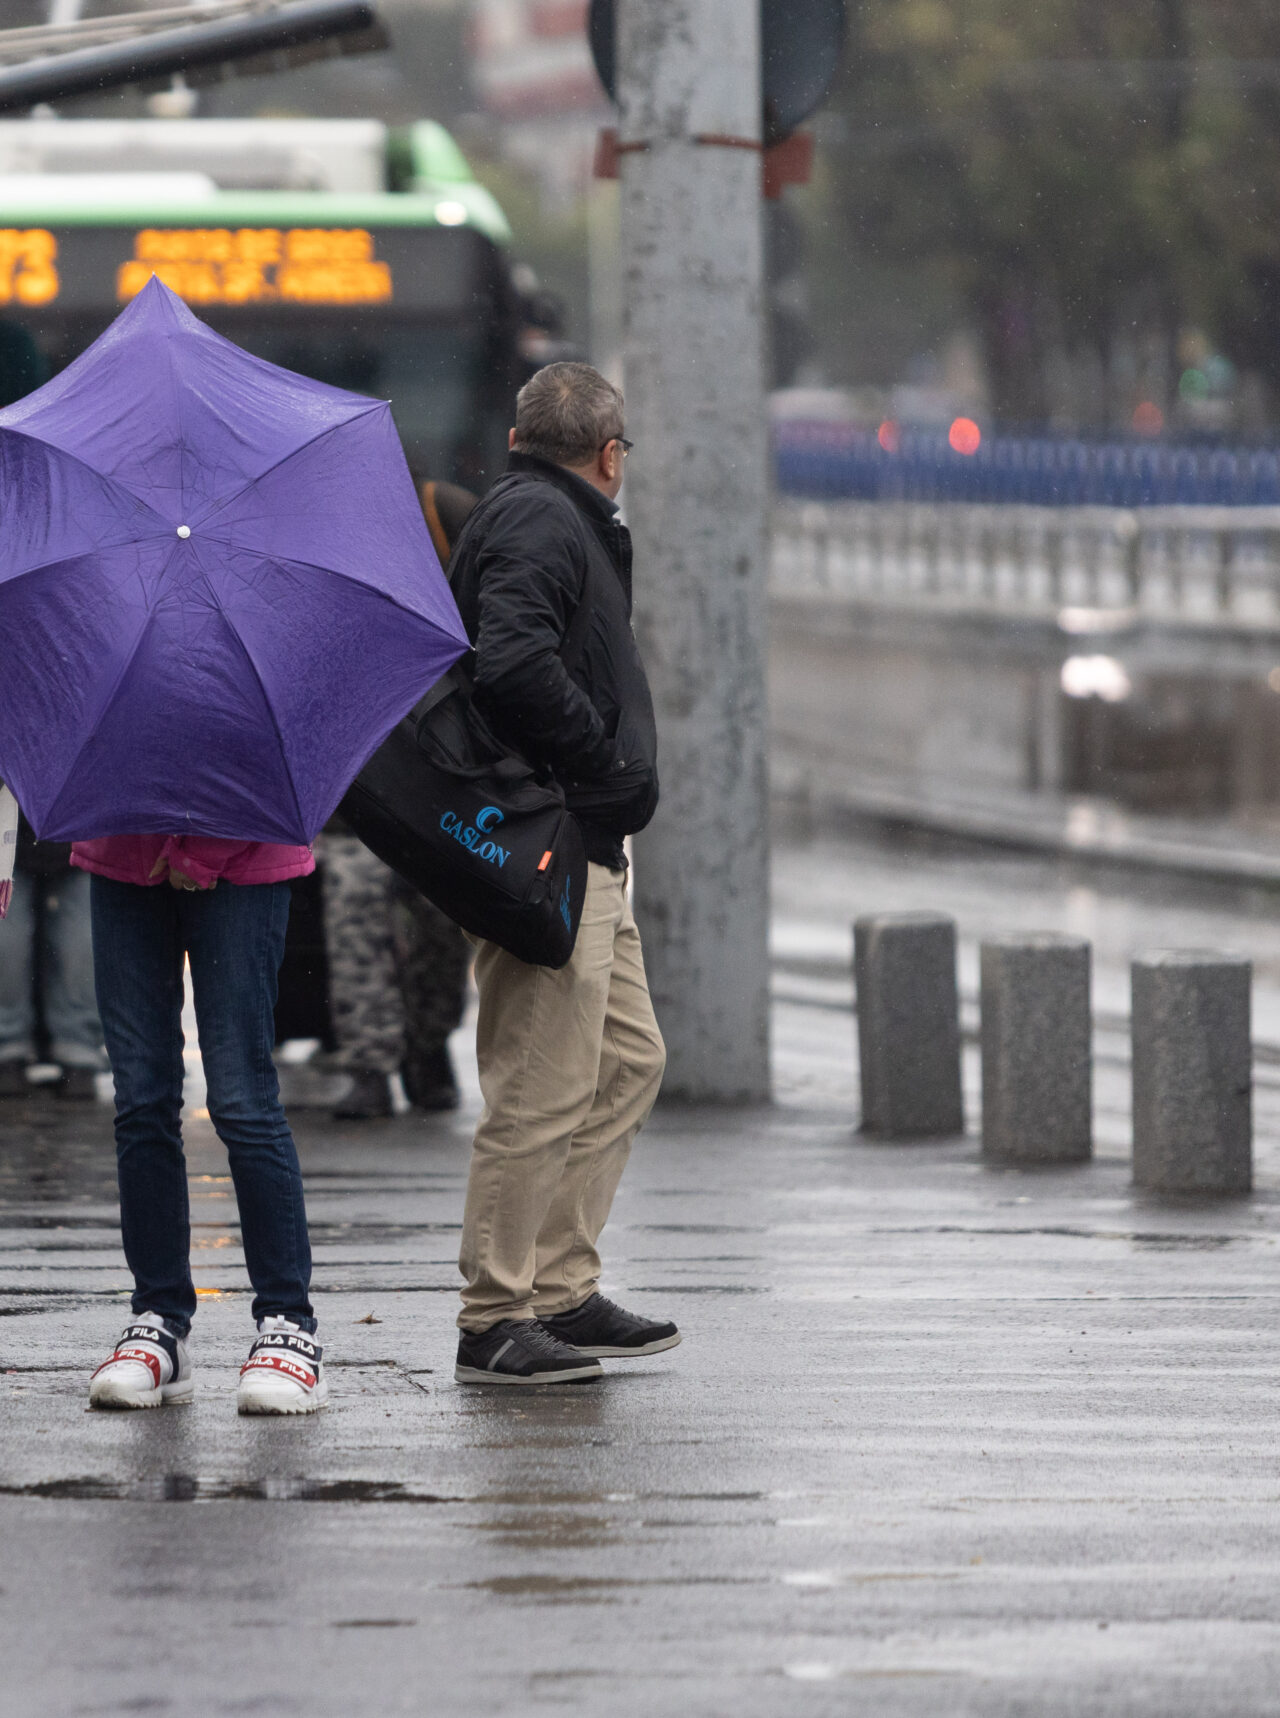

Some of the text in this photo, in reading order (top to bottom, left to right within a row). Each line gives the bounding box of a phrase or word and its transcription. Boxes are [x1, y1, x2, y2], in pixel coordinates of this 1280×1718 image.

[440, 811, 511, 868] CASLON
[131, 1327, 159, 1341] FILA
[118, 1350, 147, 1360] FILA
[256, 1335, 315, 1355] FILA FILA
[246, 1357, 307, 1380] FILA FILA
